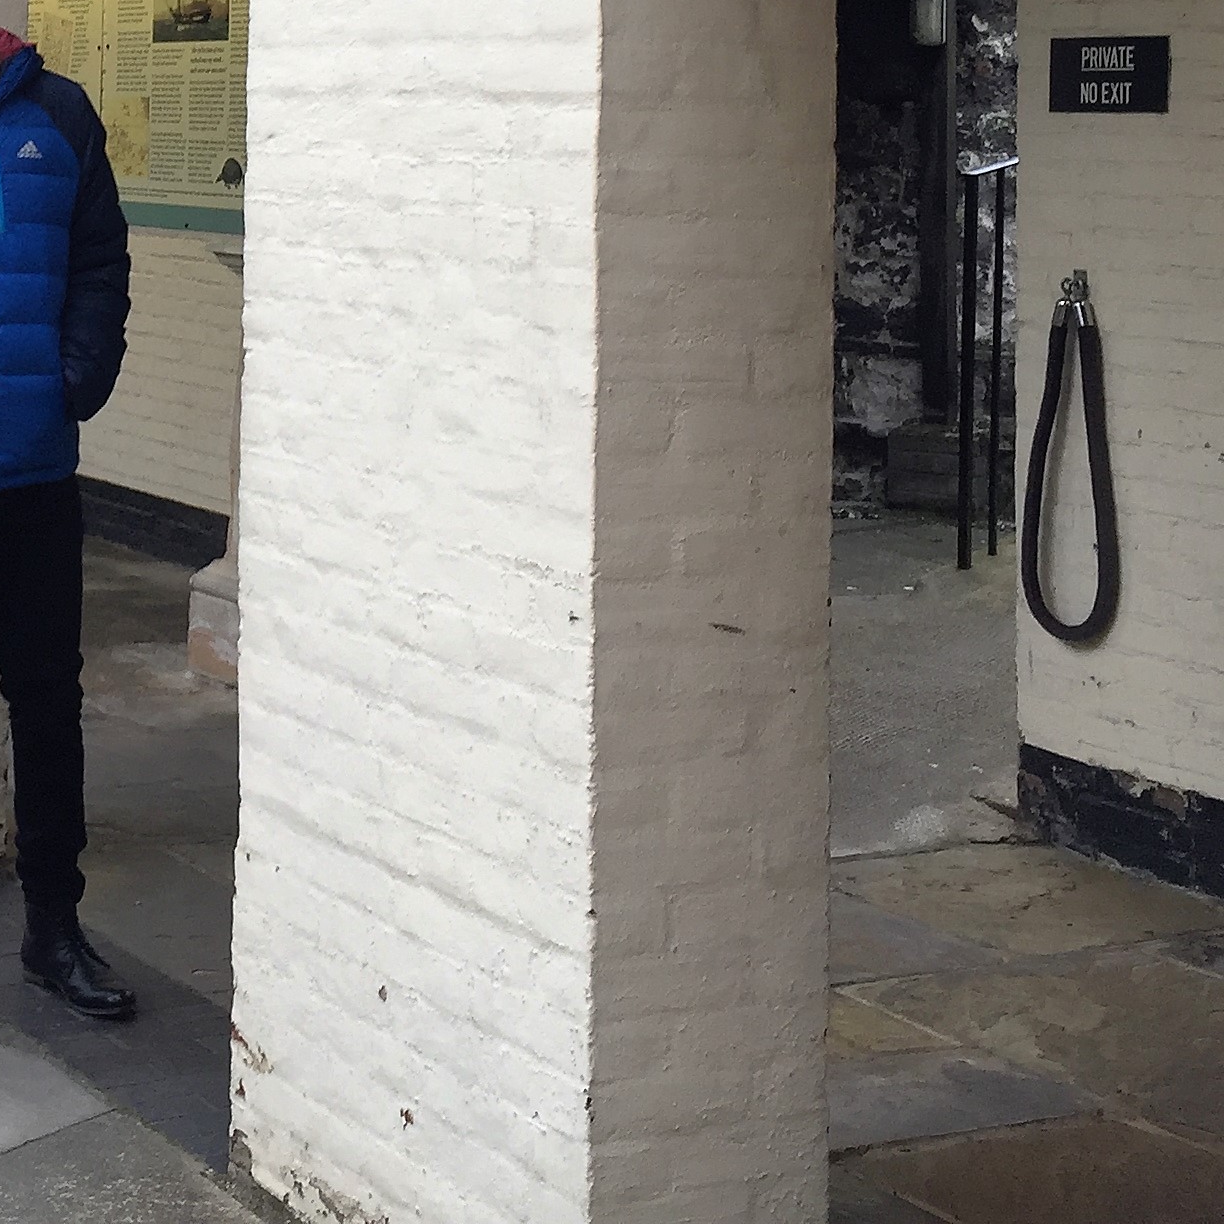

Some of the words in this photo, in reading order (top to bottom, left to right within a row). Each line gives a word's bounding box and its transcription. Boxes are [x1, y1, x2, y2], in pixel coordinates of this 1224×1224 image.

[1081, 46, 1135, 68] PRIVATE
[1080, 82, 1098, 104] NO
[1101, 82, 1132, 104] EXIT
